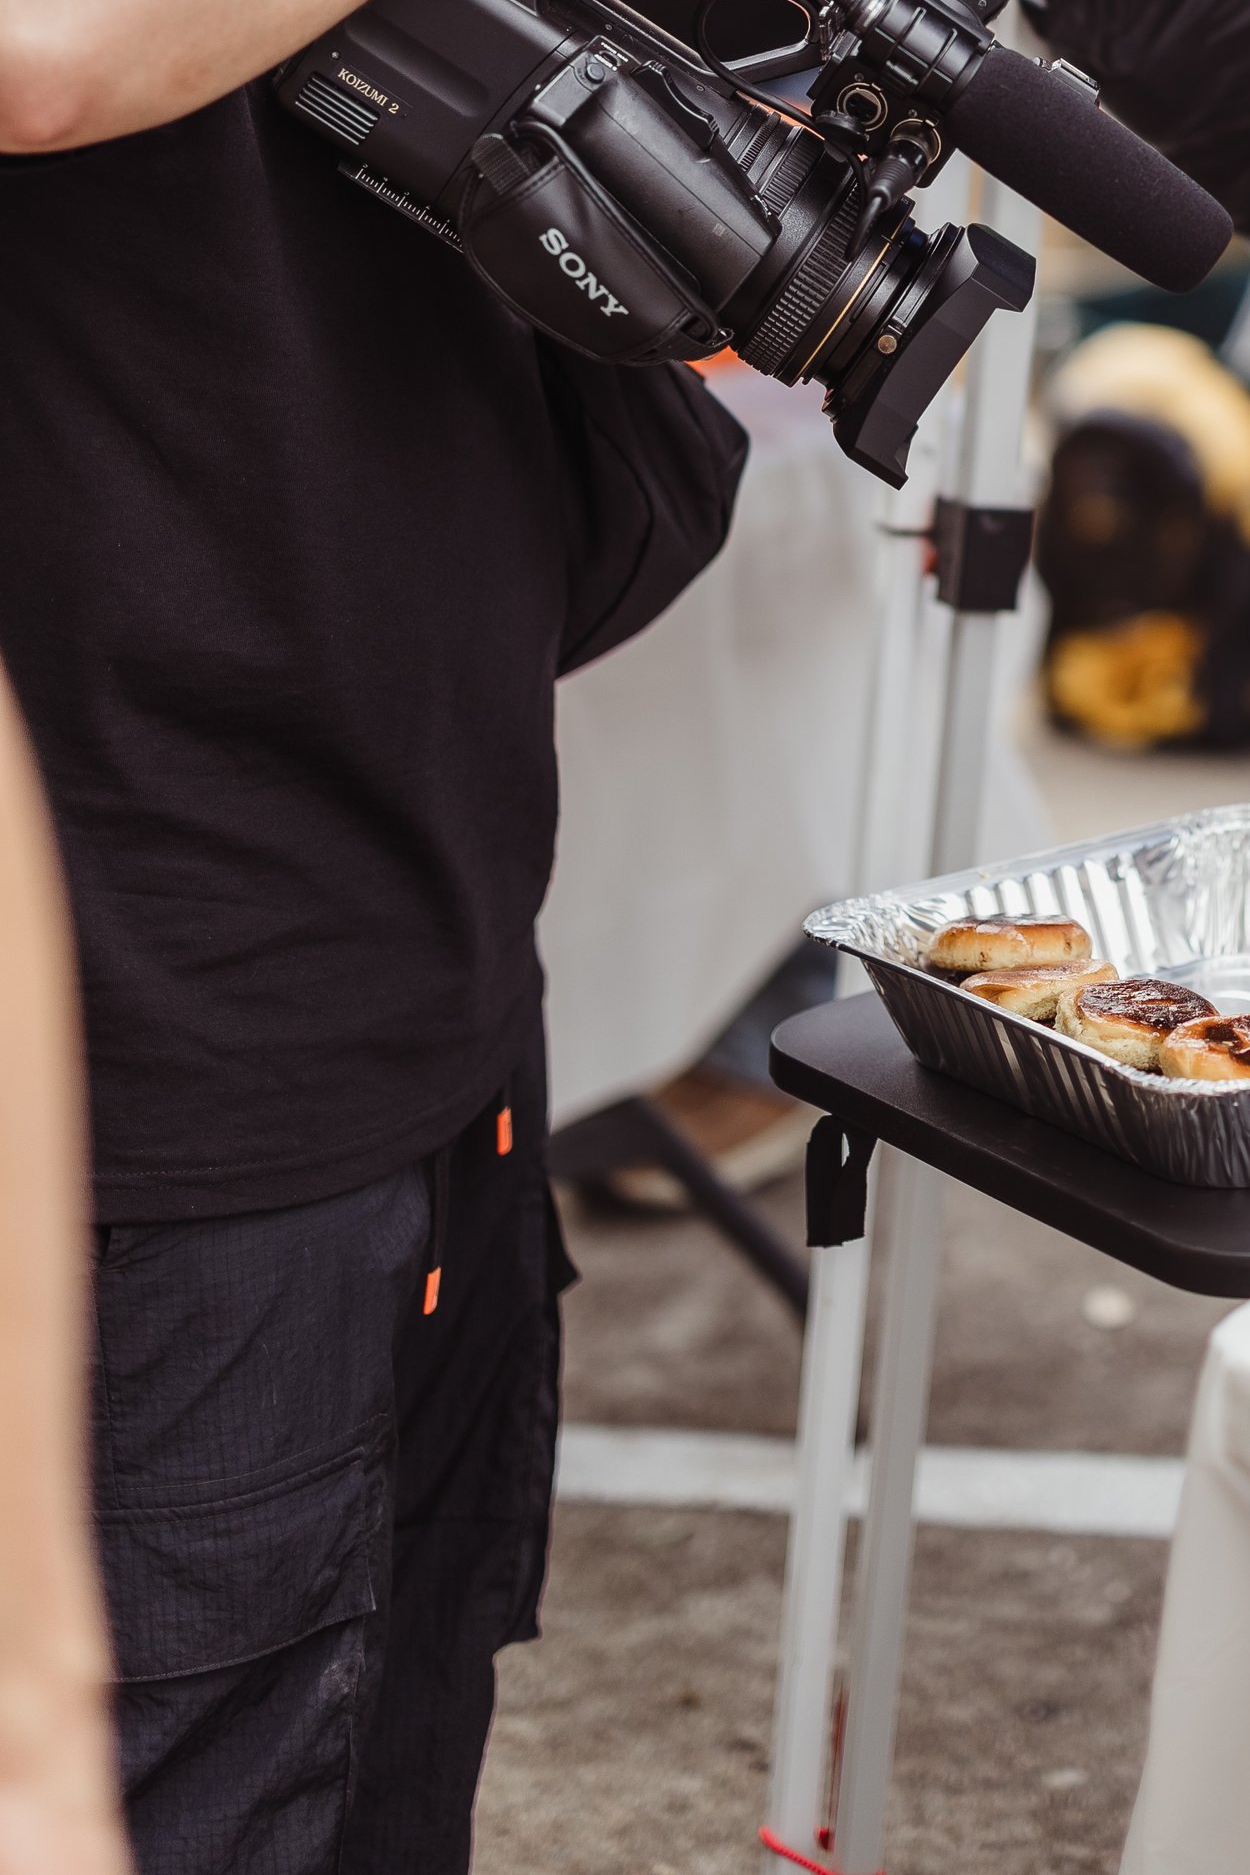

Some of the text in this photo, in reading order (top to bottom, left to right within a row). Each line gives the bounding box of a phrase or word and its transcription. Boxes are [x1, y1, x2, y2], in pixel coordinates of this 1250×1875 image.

[337, 67, 400, 115] KOIZUMI 2
[538, 227, 629, 320] SONY
